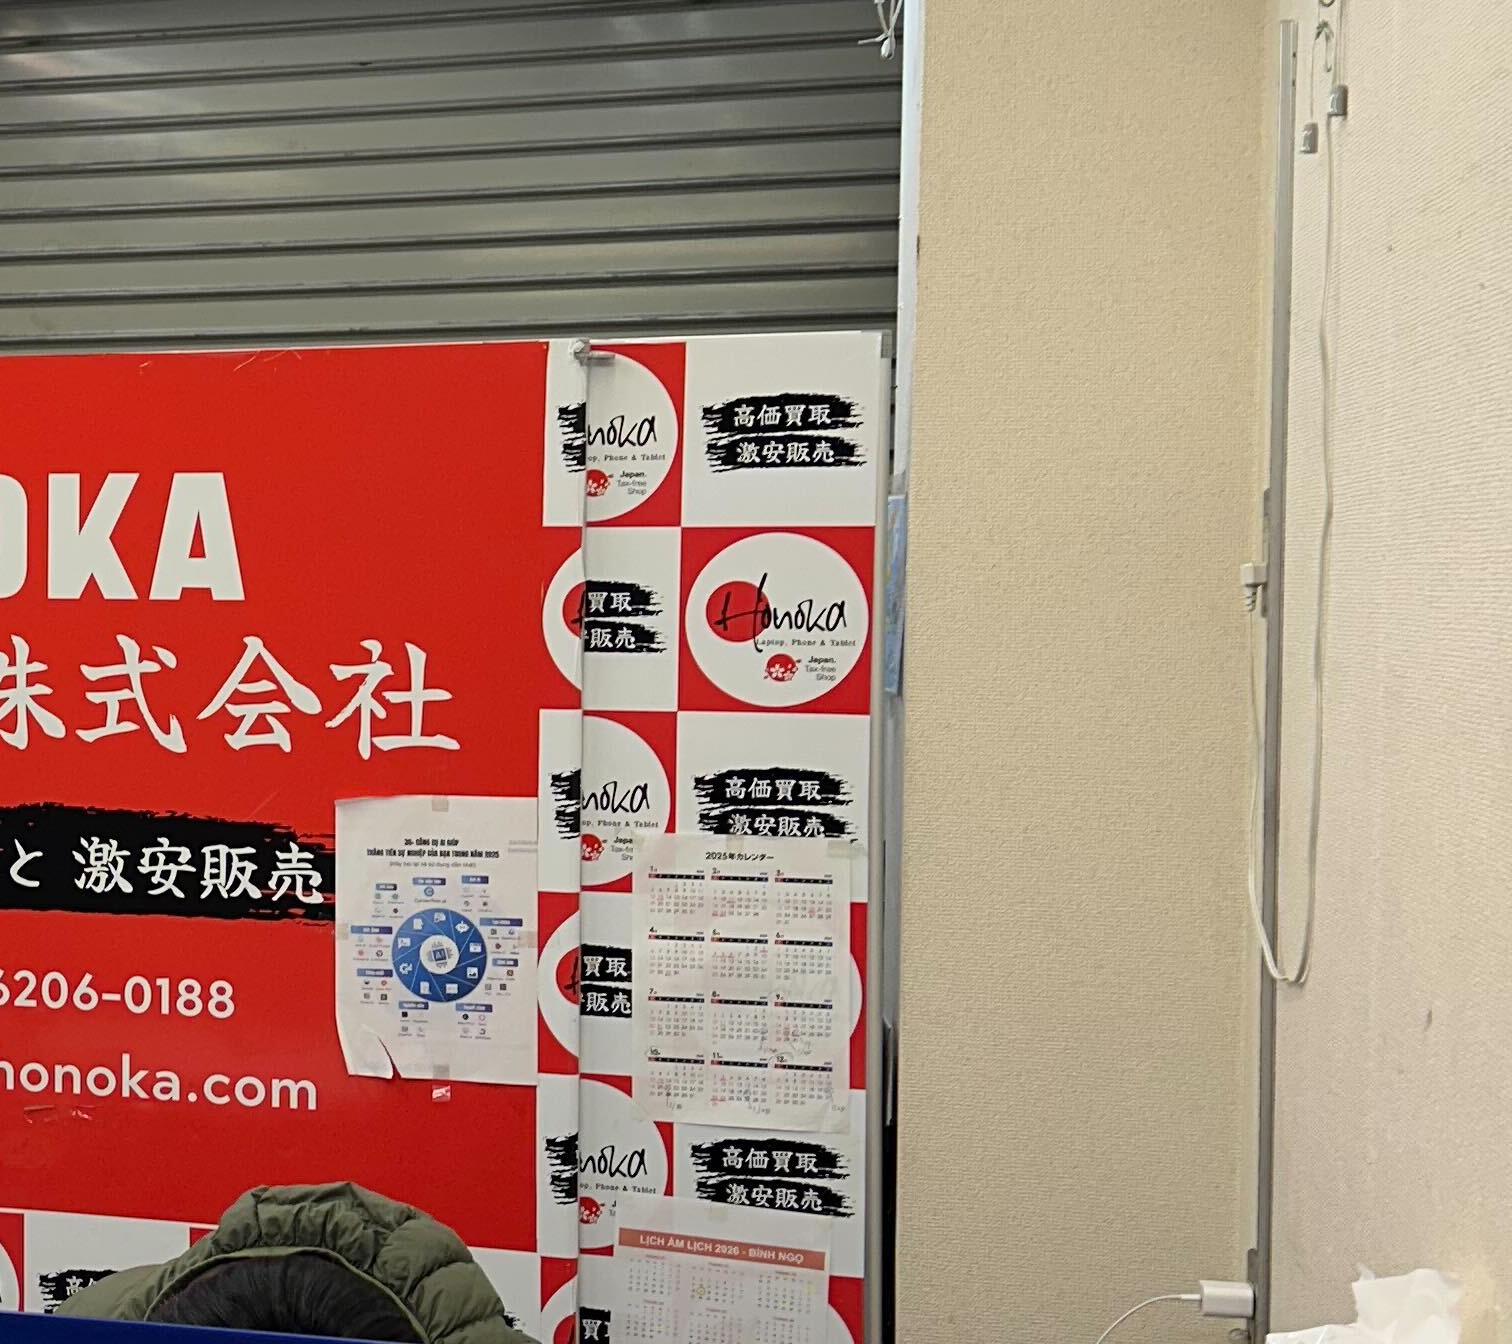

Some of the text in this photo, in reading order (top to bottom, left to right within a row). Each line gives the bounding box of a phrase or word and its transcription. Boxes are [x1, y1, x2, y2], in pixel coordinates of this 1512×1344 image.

[734, 403, 833, 427] 高価買取
[736, 441, 835, 464] 激安販売
[714, 572, 847, 653] Honoka
[583, 628, 636, 649] 販売
[725, 776, 822, 801] 高価買取
[728, 814, 825, 836] 激安販売
[705, 852, 774, 861] 2025年カレンダー
[11, 839, 42, 888] と
[72, 835, 325, 904] 激安販売
[580, 992, 631, 1014] 販売
[722, 1145, 818, 1172] 高価買取
[726, 1183, 823, 1211] 激安販売
[639, 1235, 665, 1247] LỊCH
[687, 1240, 713, 1253] LỊCH
